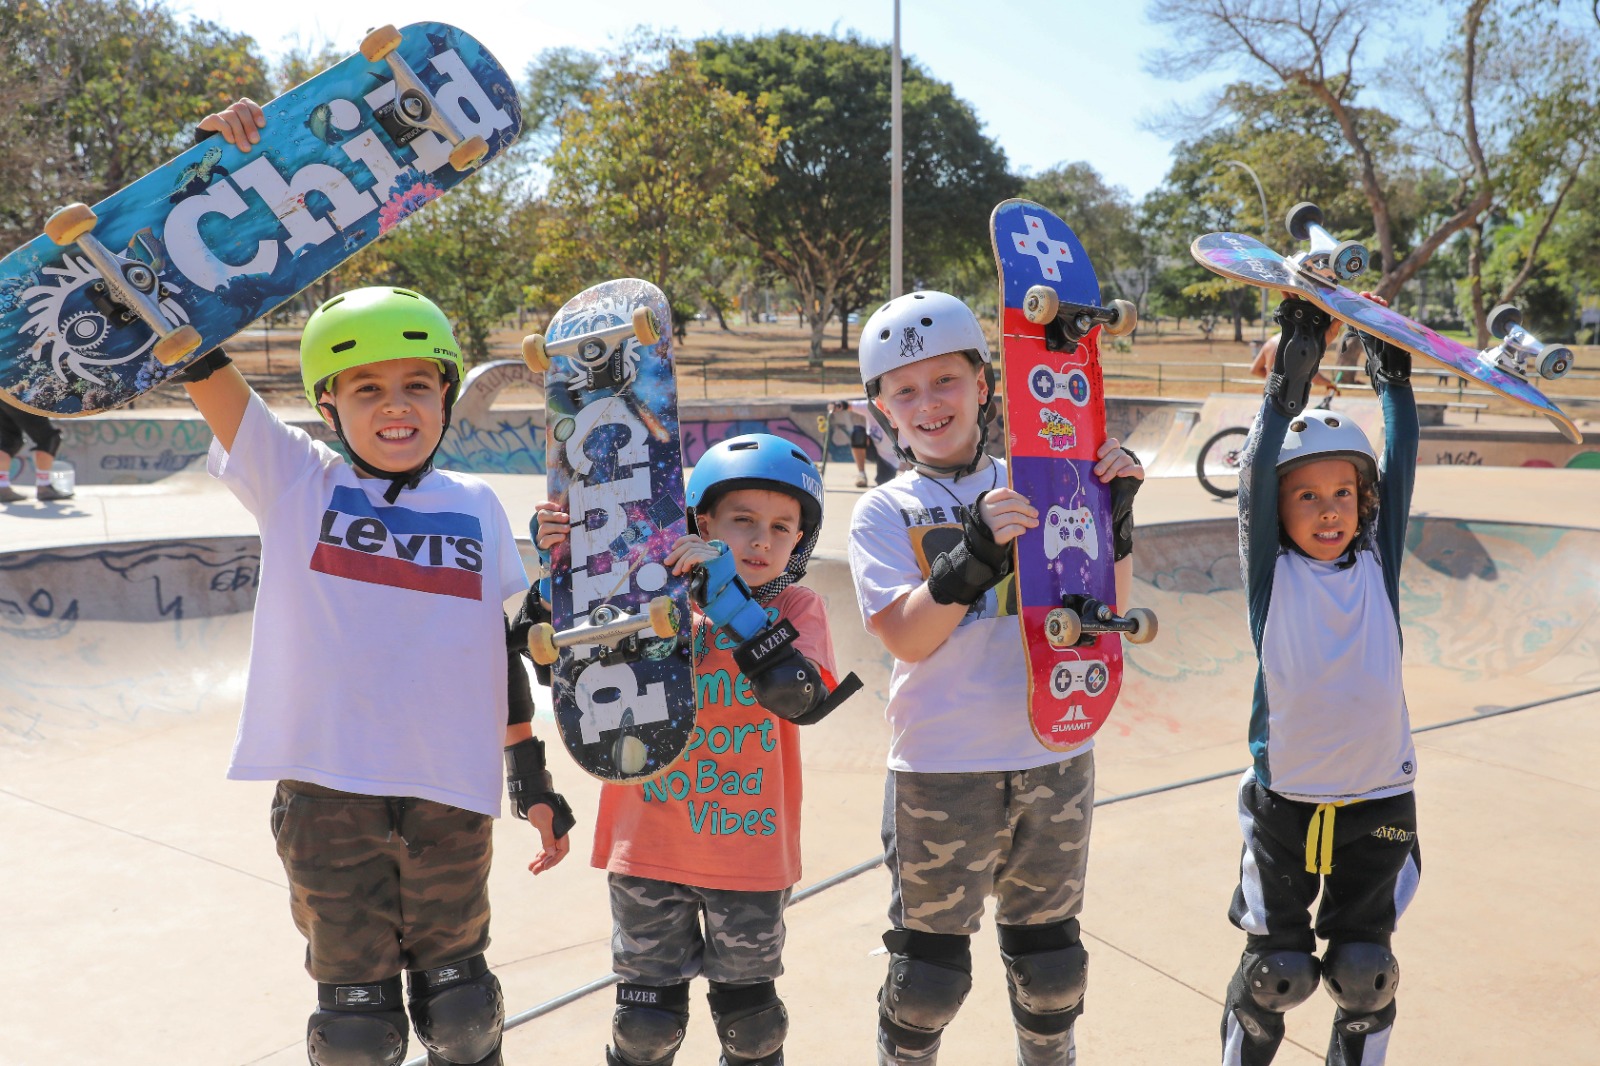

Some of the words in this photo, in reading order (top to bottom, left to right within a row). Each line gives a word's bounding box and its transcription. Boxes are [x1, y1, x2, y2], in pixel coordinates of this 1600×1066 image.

[900, 505, 948, 528] THE
[750, 627, 791, 660] LAZER
[683, 718, 777, 762] port
[1051, 721, 1093, 733] SUMMIT
[695, 759, 763, 796] Bad
[687, 800, 777, 836] Vibes
[621, 988, 657, 1003] LAZER
